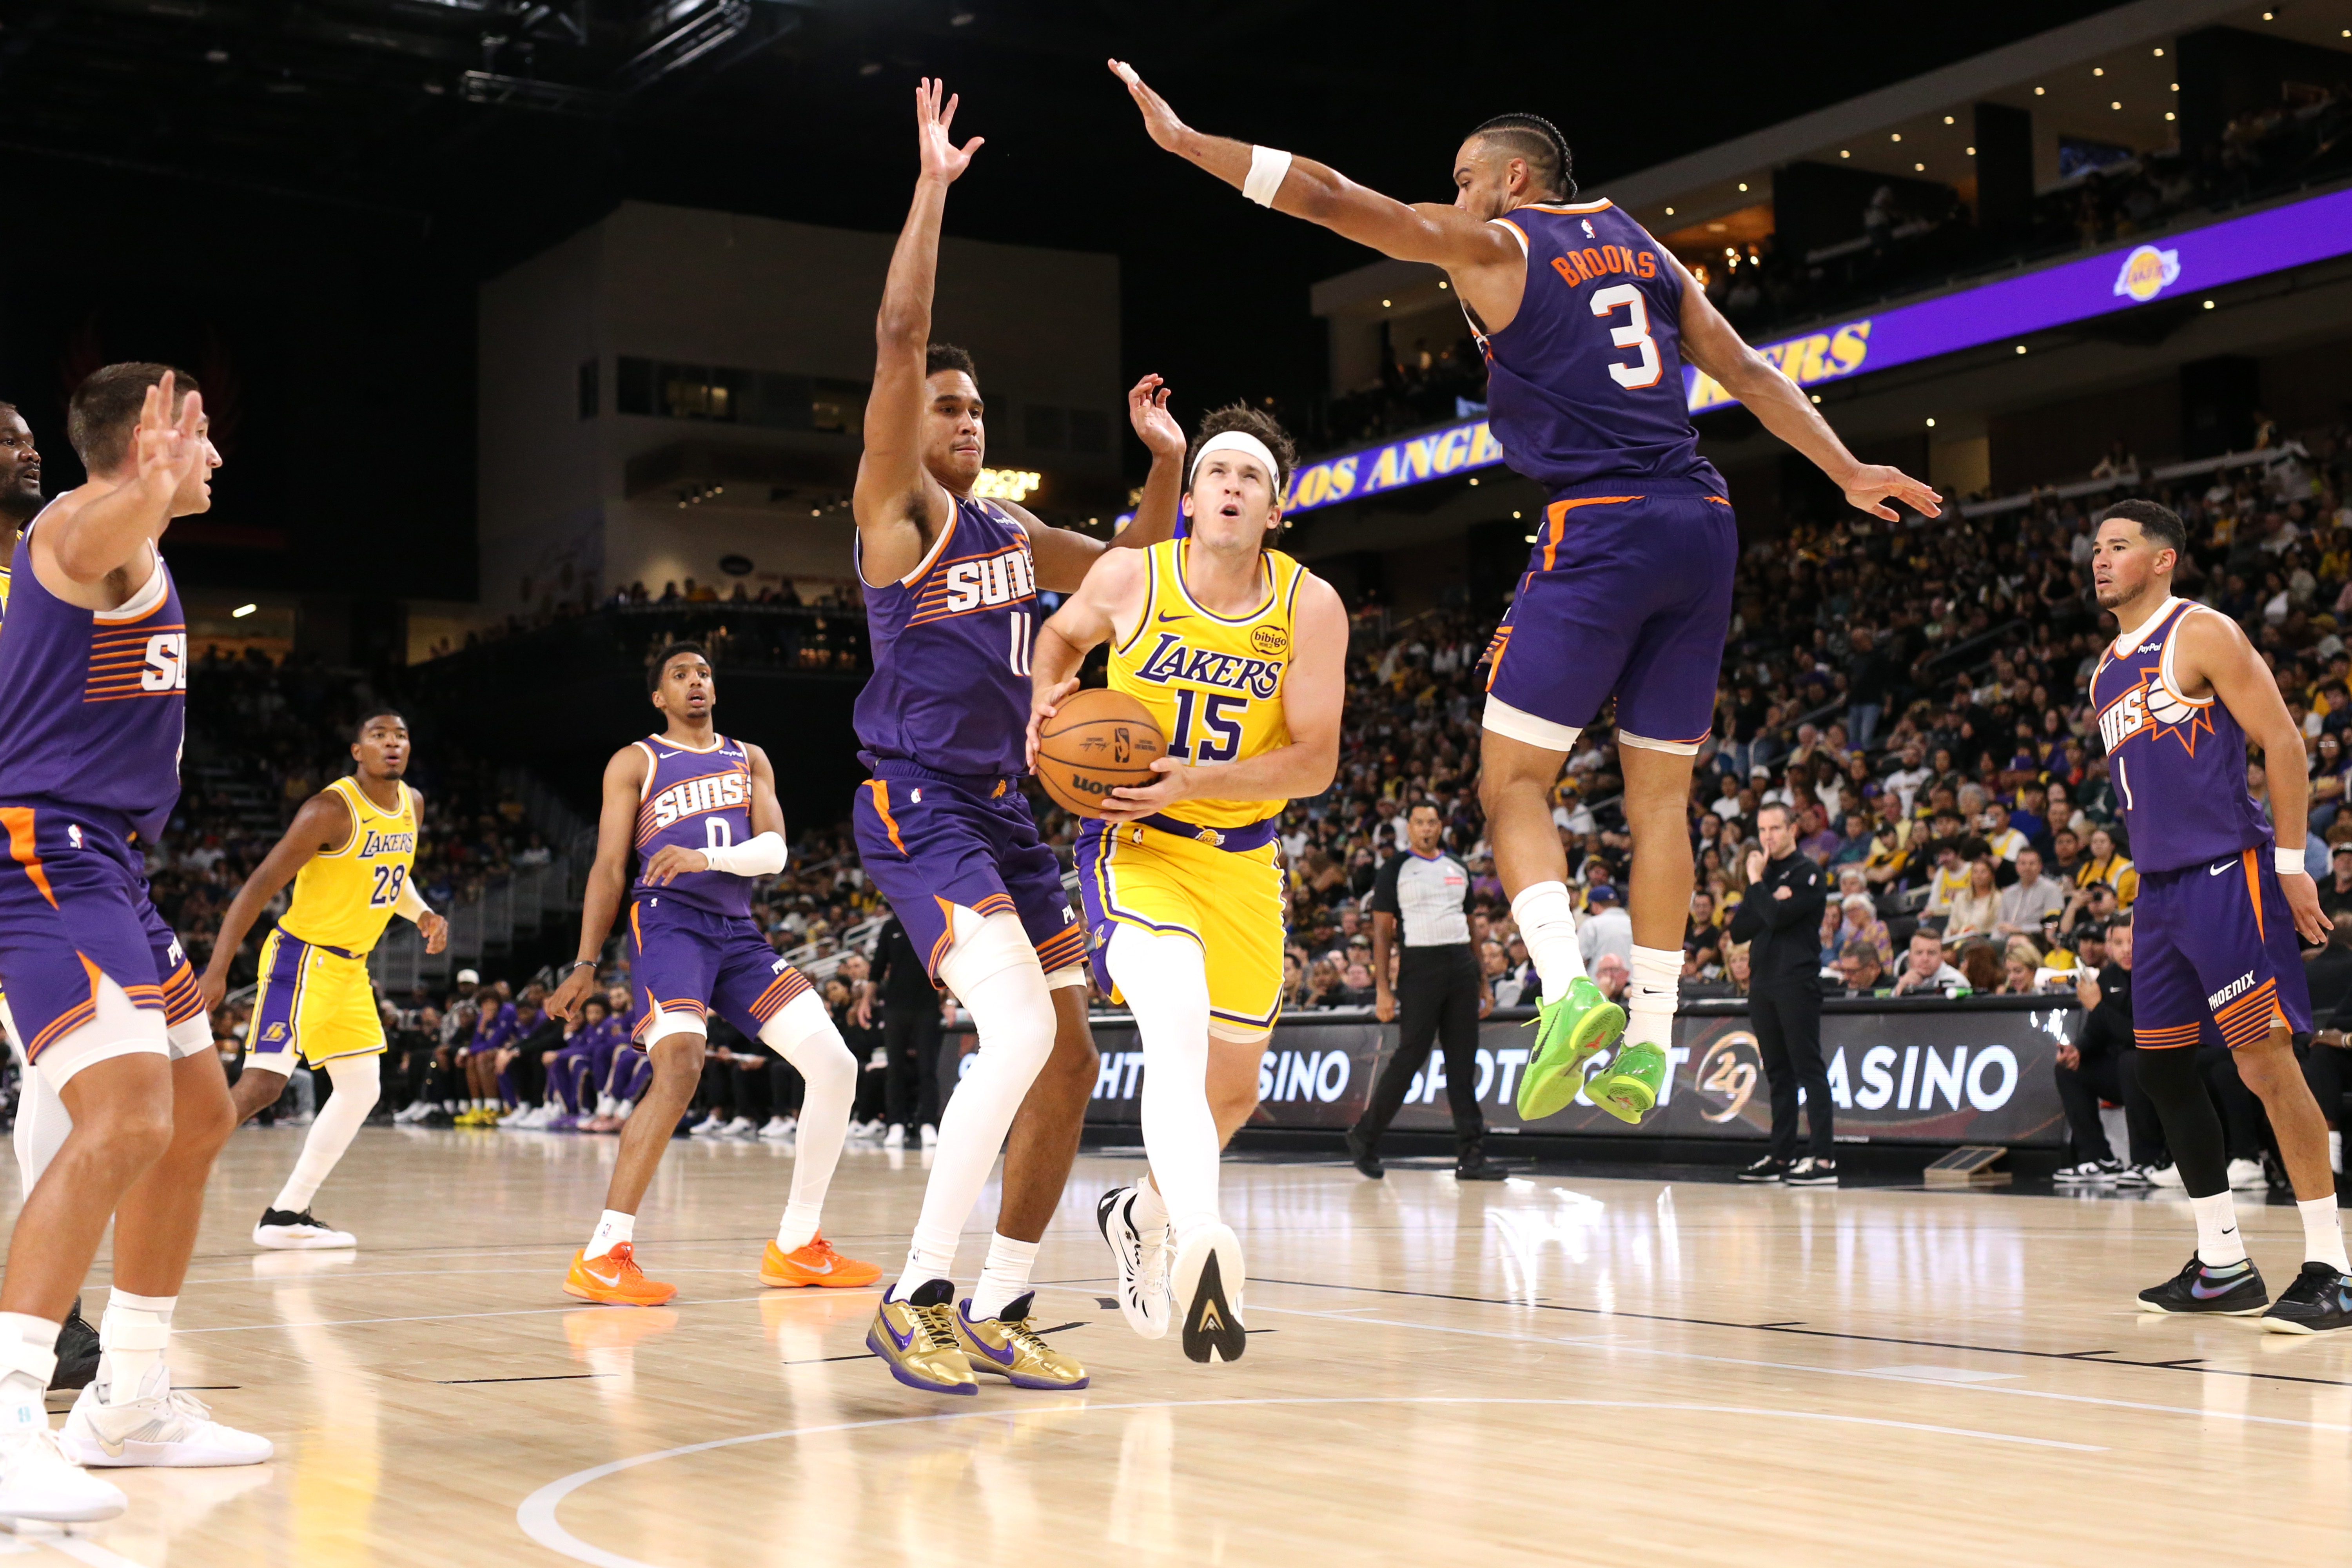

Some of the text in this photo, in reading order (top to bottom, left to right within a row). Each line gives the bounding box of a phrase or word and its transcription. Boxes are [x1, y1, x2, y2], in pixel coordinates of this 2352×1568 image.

[1551, 245, 1655, 288] BROOKS
[1590, 283, 1663, 390] 3
[1010, 611, 1032, 676] 11
[1134, 631, 1284, 701] LAKERS
[1254, 631, 1287, 648] bibigo
[2138, 642, 2162, 654] PayPal
[1167, 688, 1250, 767] 15
[2098, 689, 2143, 757] UNS
[654, 773, 744, 828] SUNS
[2119, 757, 2132, 810] 1
[357, 830, 413, 858] LAKERS
[370, 863, 406, 909] 28
[2208, 969, 2256, 1011] PHOENIX
[1258, 1050, 1351, 1103] SINO
[1798, 1045, 2019, 1112] ASINO
